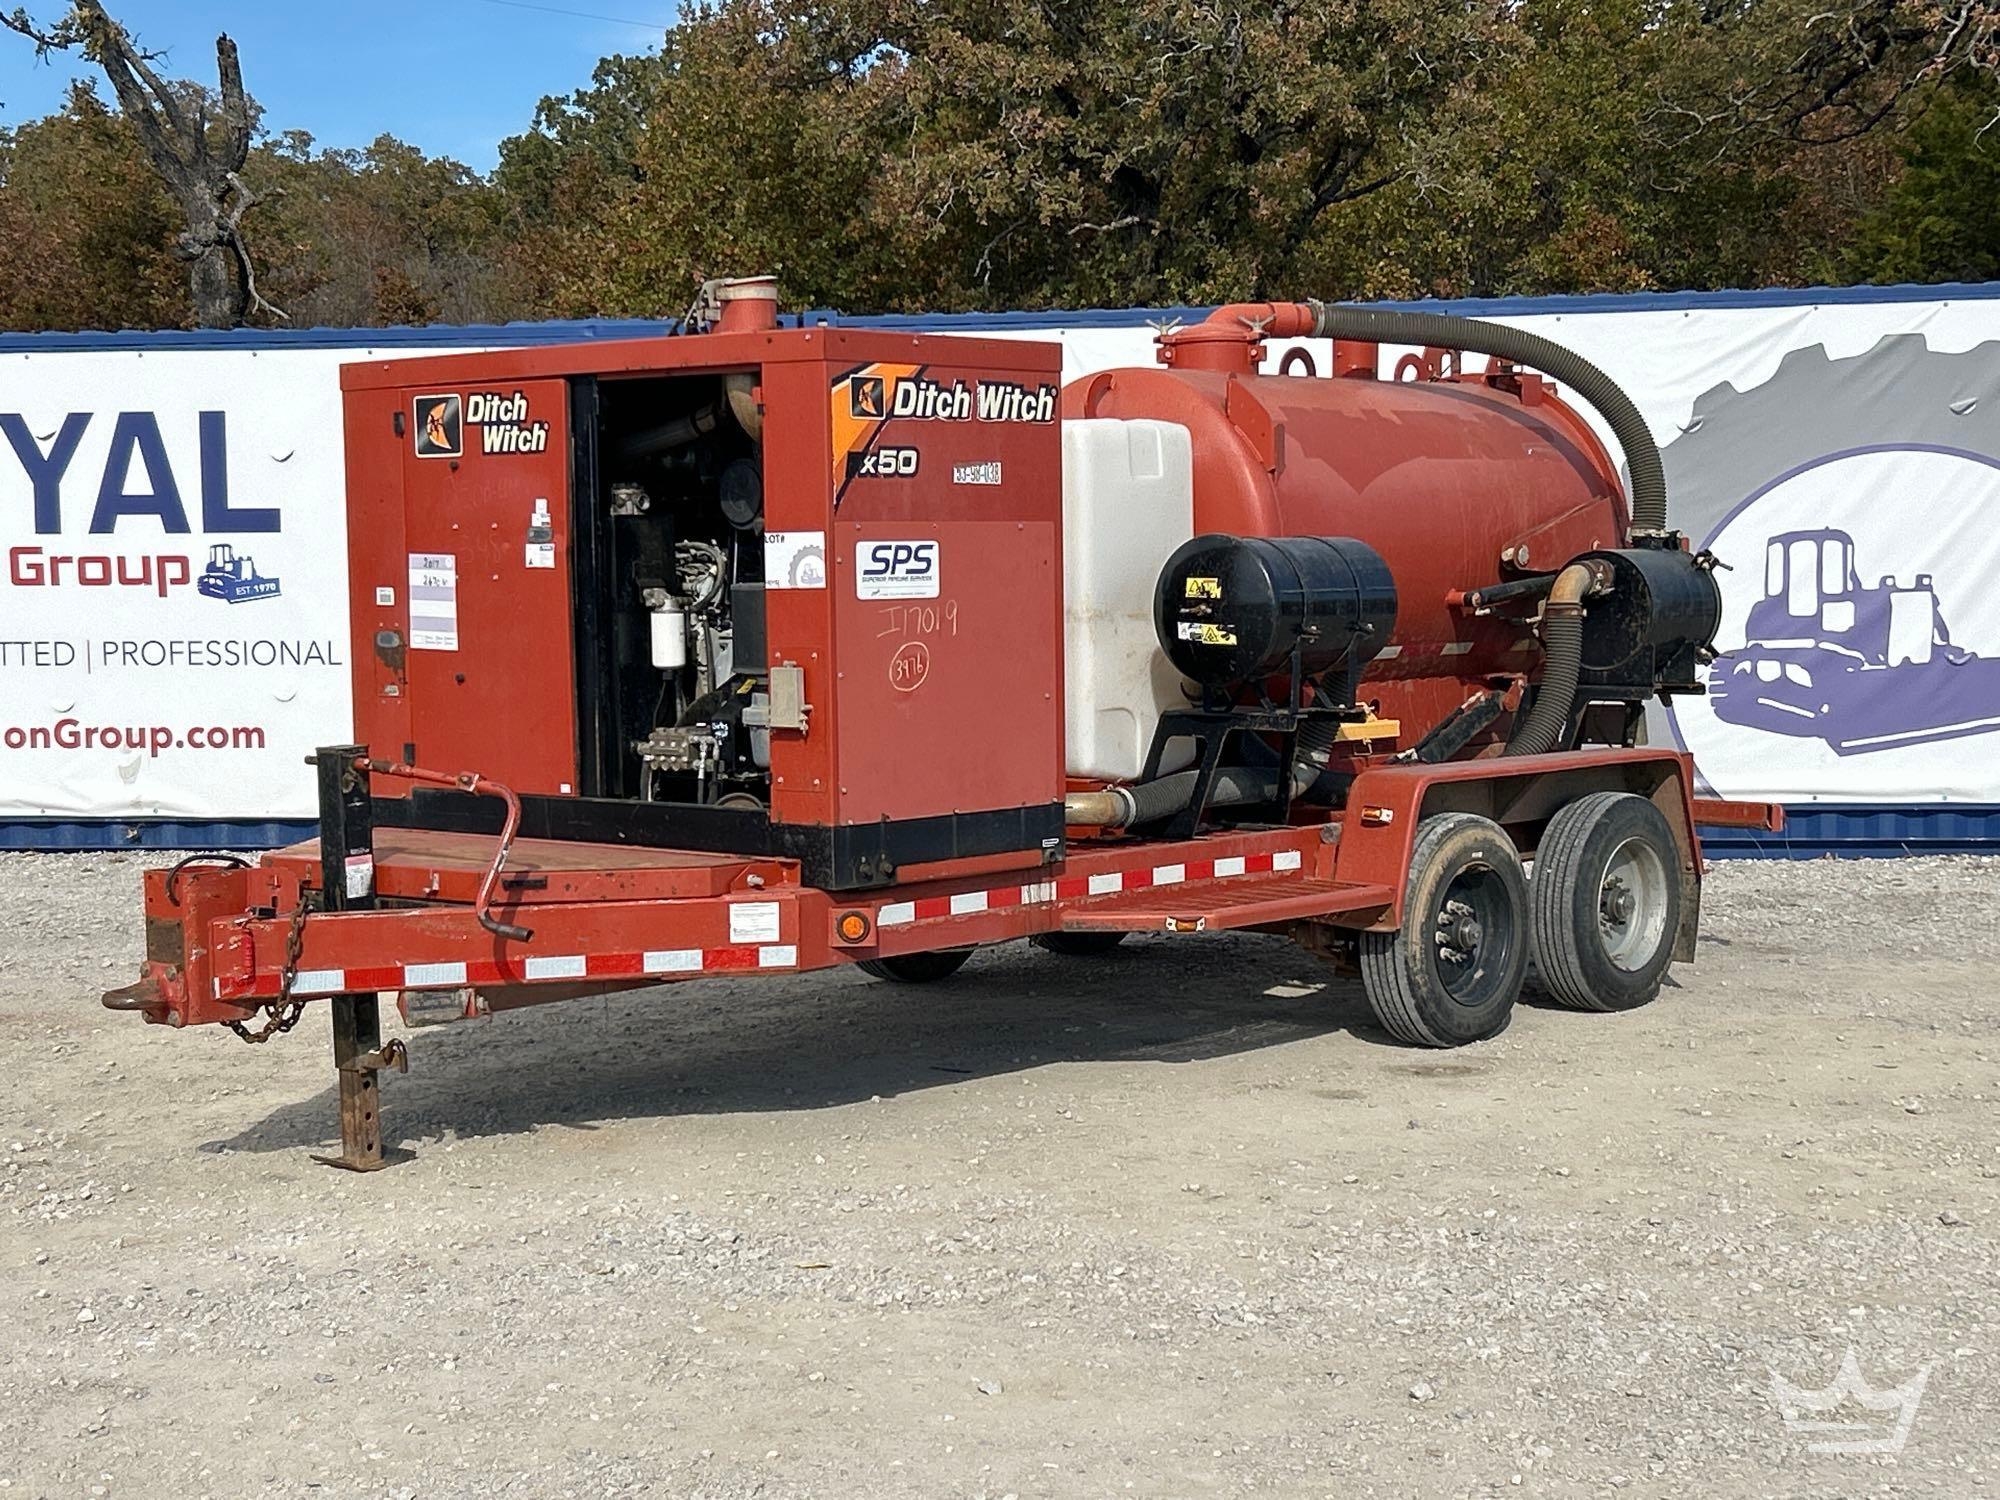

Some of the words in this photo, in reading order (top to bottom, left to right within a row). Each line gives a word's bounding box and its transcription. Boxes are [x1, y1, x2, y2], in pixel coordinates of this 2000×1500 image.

[465, 391, 528, 423] Ditch
[892, 380, 972, 418] Ditch
[976, 383, 1055, 421] Witch
[482, 422, 549, 453] Witch
[0, 410, 281, 534] YAL
[9, 546, 190, 598] Group
[862, 544, 936, 576] SPS
[253, 582, 277, 593] 1970
[102, 639, 343, 667] PROFESSIONAL
[3, 718, 266, 758] onGroup.com
